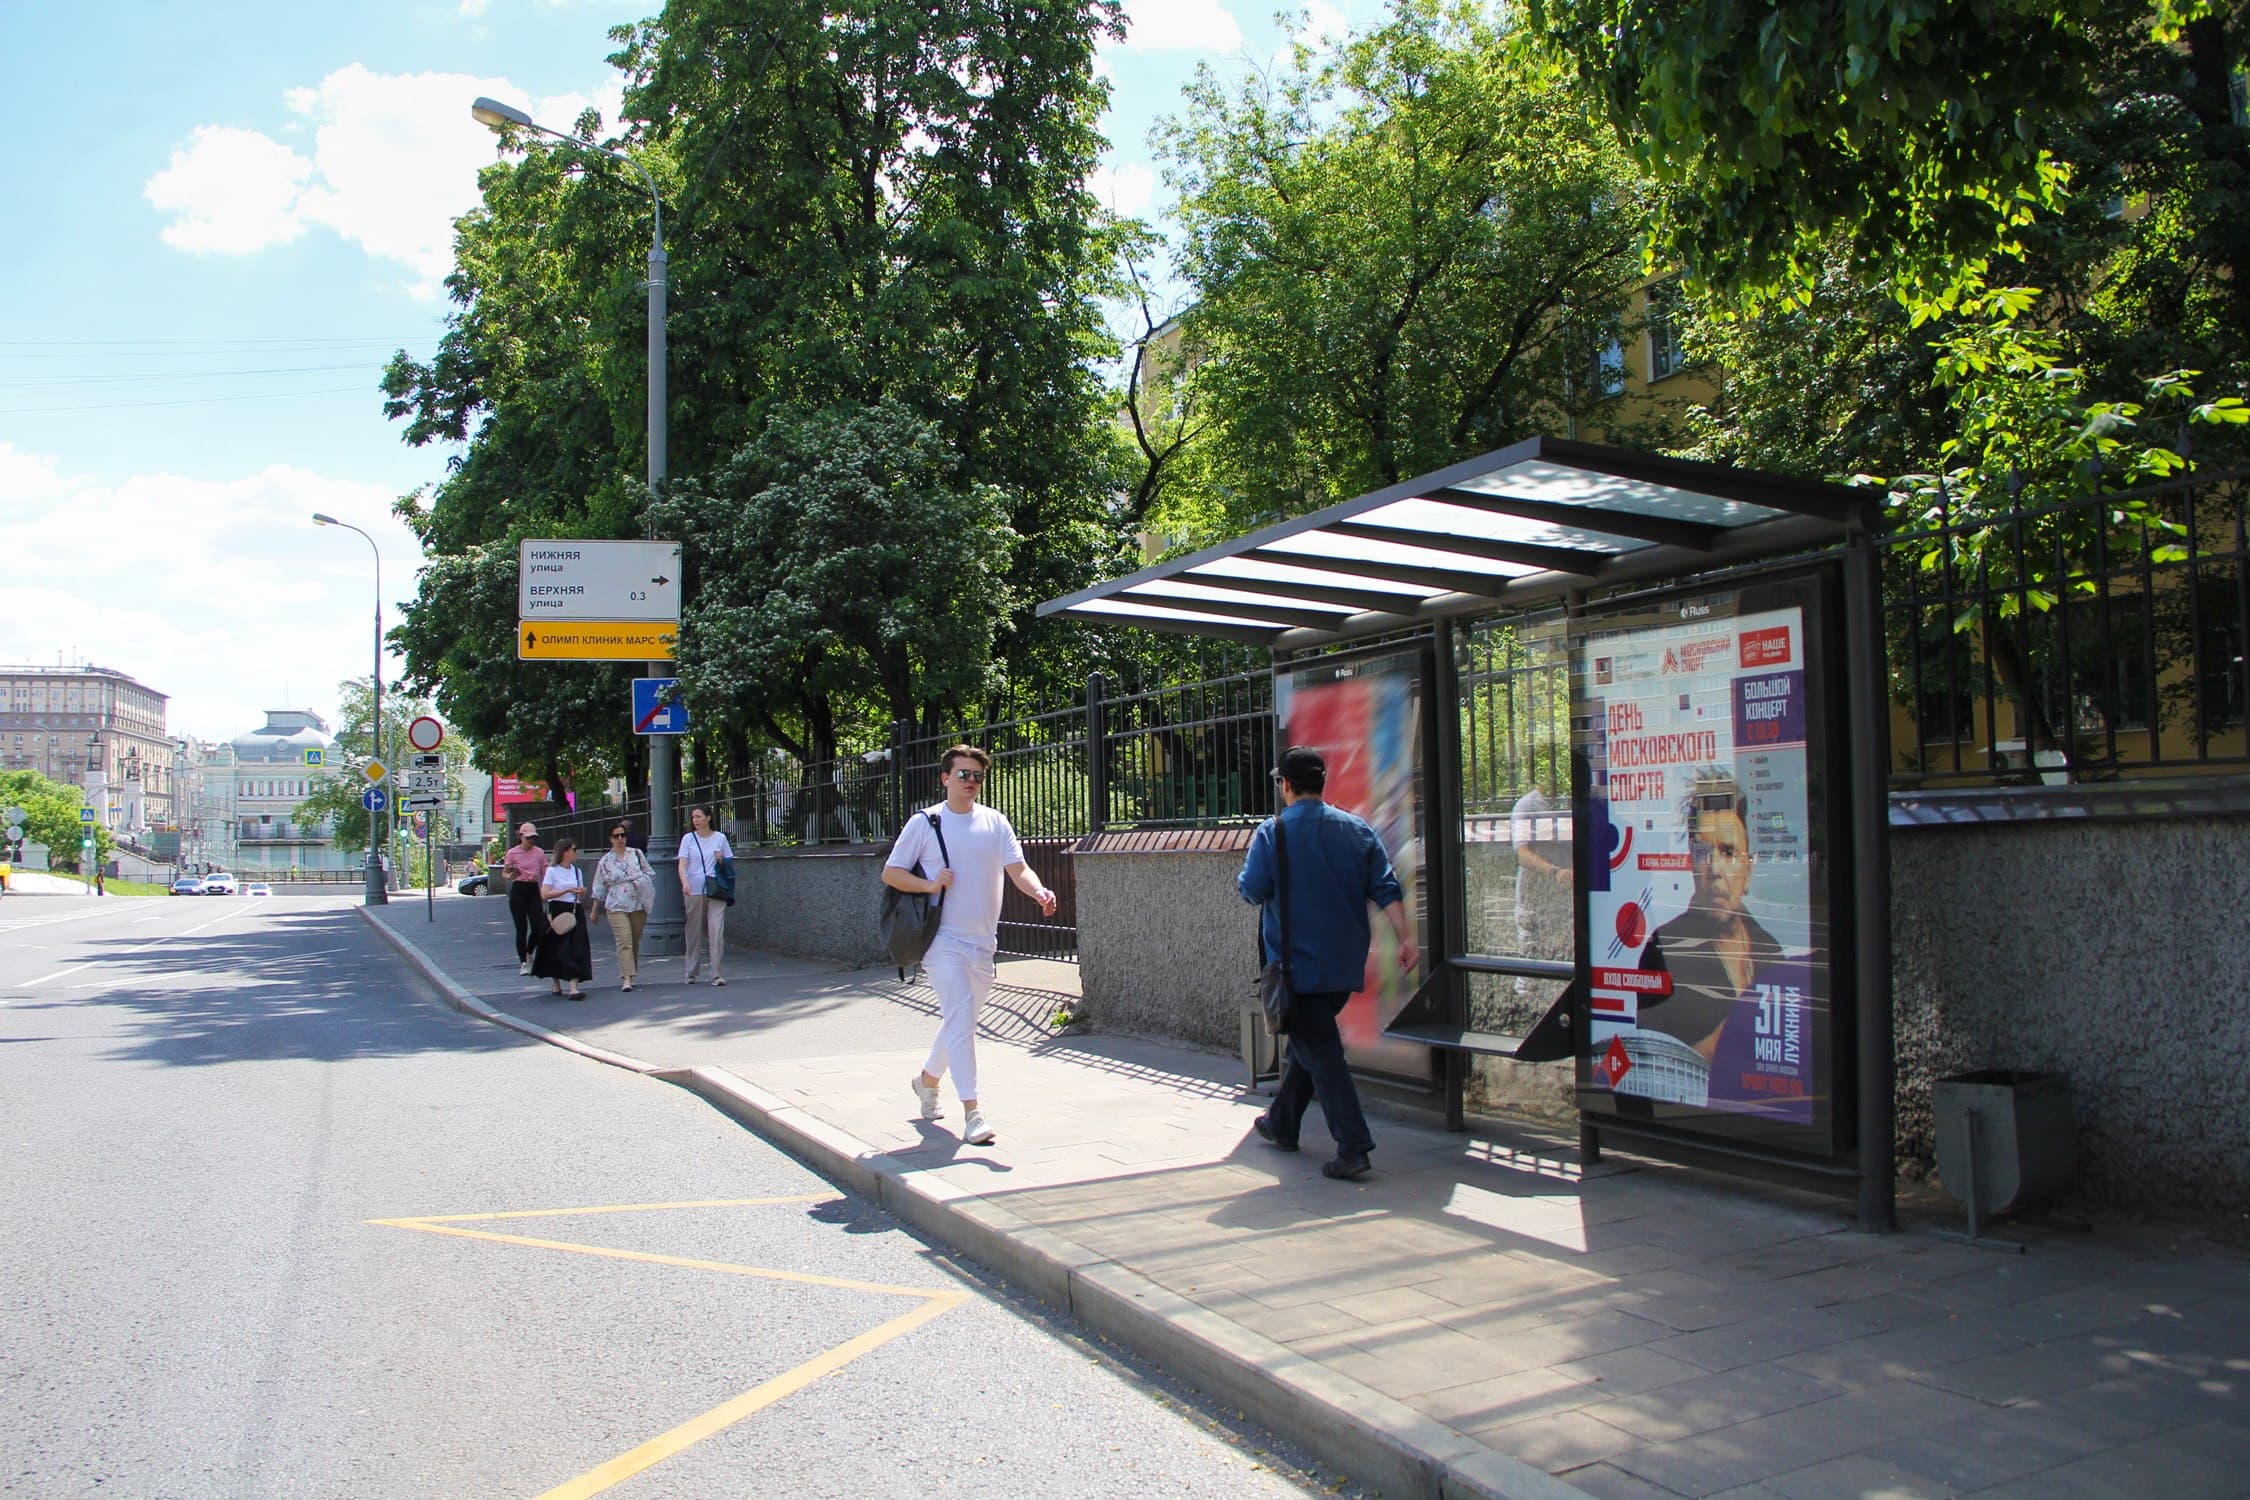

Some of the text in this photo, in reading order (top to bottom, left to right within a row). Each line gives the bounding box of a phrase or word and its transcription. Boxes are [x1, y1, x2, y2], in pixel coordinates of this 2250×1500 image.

[531, 551, 581, 560] НИЖНЯЯ
[530, 563, 563, 573] улица
[530, 586, 584, 595] ВЕРХНЯЯ
[529, 599, 563, 609] улица
[1689, 606, 1710, 617] Russ
[542, 635, 580, 644] ОЛИМП
[582, 636, 623, 645] КЛИНИК
[626, 636, 655, 645] МАРС
[1762, 638, 1786, 650] НАШЕ
[1744, 677, 1790, 700] БОЛЬШОЙ
[1608, 702, 1643, 736] ДЕНЬ
[1745, 700, 1788, 721] КОНЦЕРТ
[1608, 730, 1716, 768] МОСКОВСКОГО
[1609, 771, 1665, 802] СПОРТА
[1603, 972, 1662, 989] ВХОД СВОБОДНЫЙ
[1755, 983, 1780, 1036] 31
[1784, 986, 1800, 1065] ЛУЖНИКИ
[1755, 1037, 1780, 1063] МАЯ
[1611, 1058, 1622, 1071] 0+
